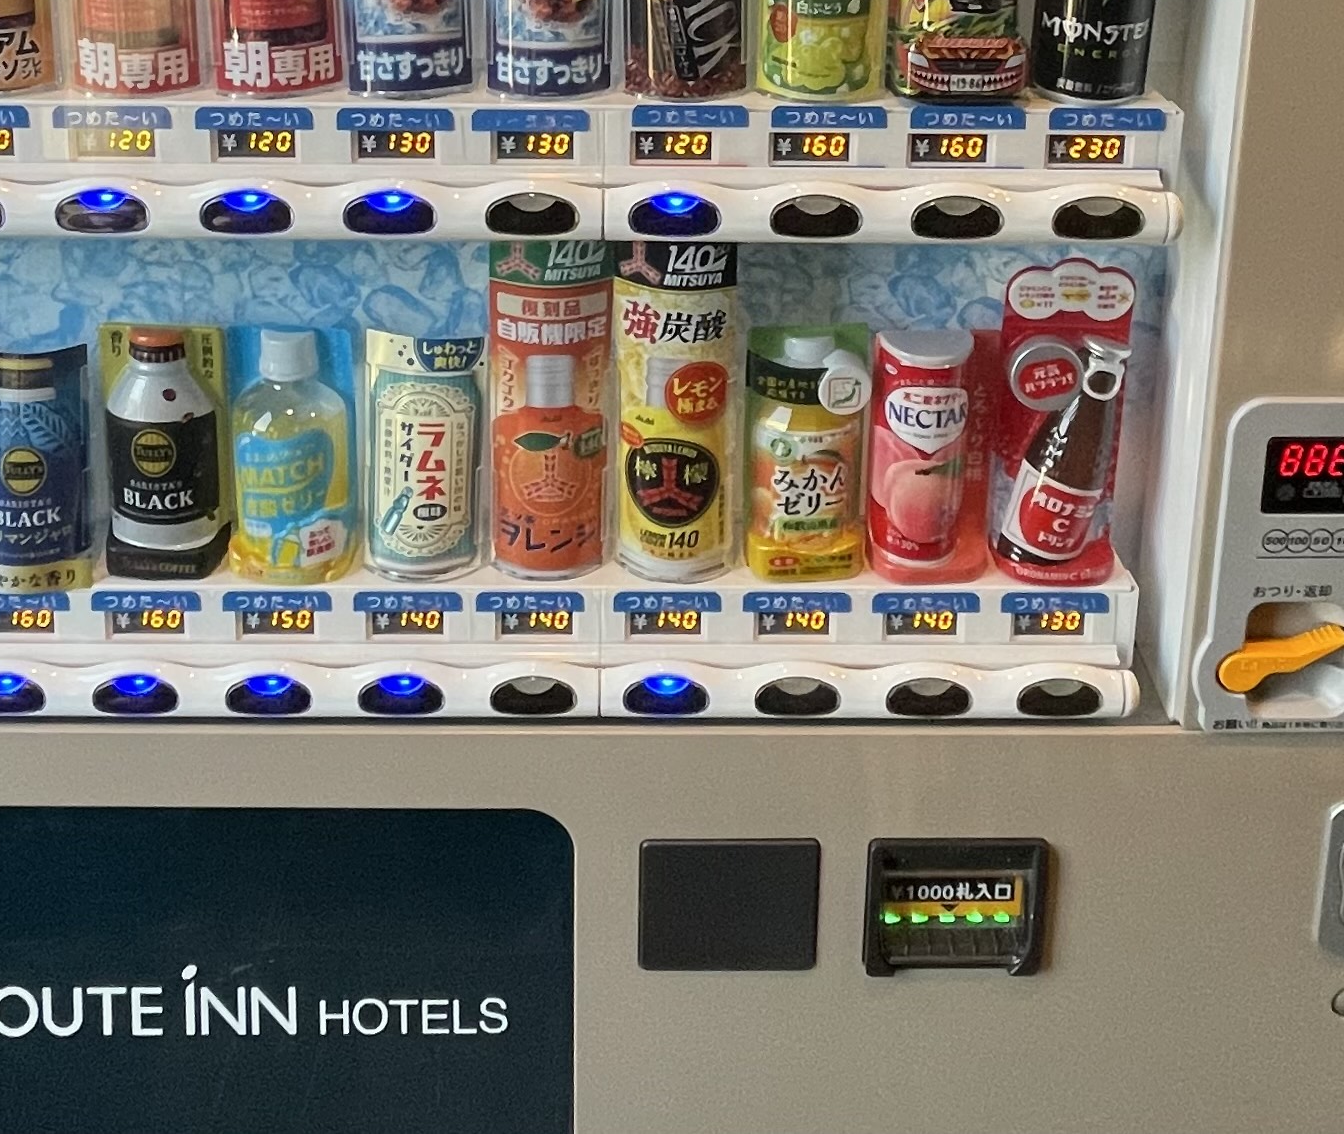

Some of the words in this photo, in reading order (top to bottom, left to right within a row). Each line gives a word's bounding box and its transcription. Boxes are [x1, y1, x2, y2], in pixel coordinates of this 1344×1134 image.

[77, 38, 190, 90] 朝専用
[223, 40, 336, 88] 朝専用
[357, 48, 465, 83] 甘さすっきり
[495, 52, 603, 88] 甘さすっきり
[662, 272, 723, 287] MITSUYA
[495, 319, 606, 346] 自販機限定
[623, 301, 728, 344] 強炭酸
[400, 421, 414, 482] サイダー
[416, 422, 447, 501] ラムネ
[773, 468, 845, 493] みかん
[123, 487, 195, 511] BLACK
[776, 492, 844, 516] ゼリー
[318, 996, 509, 1035] HOTELS
